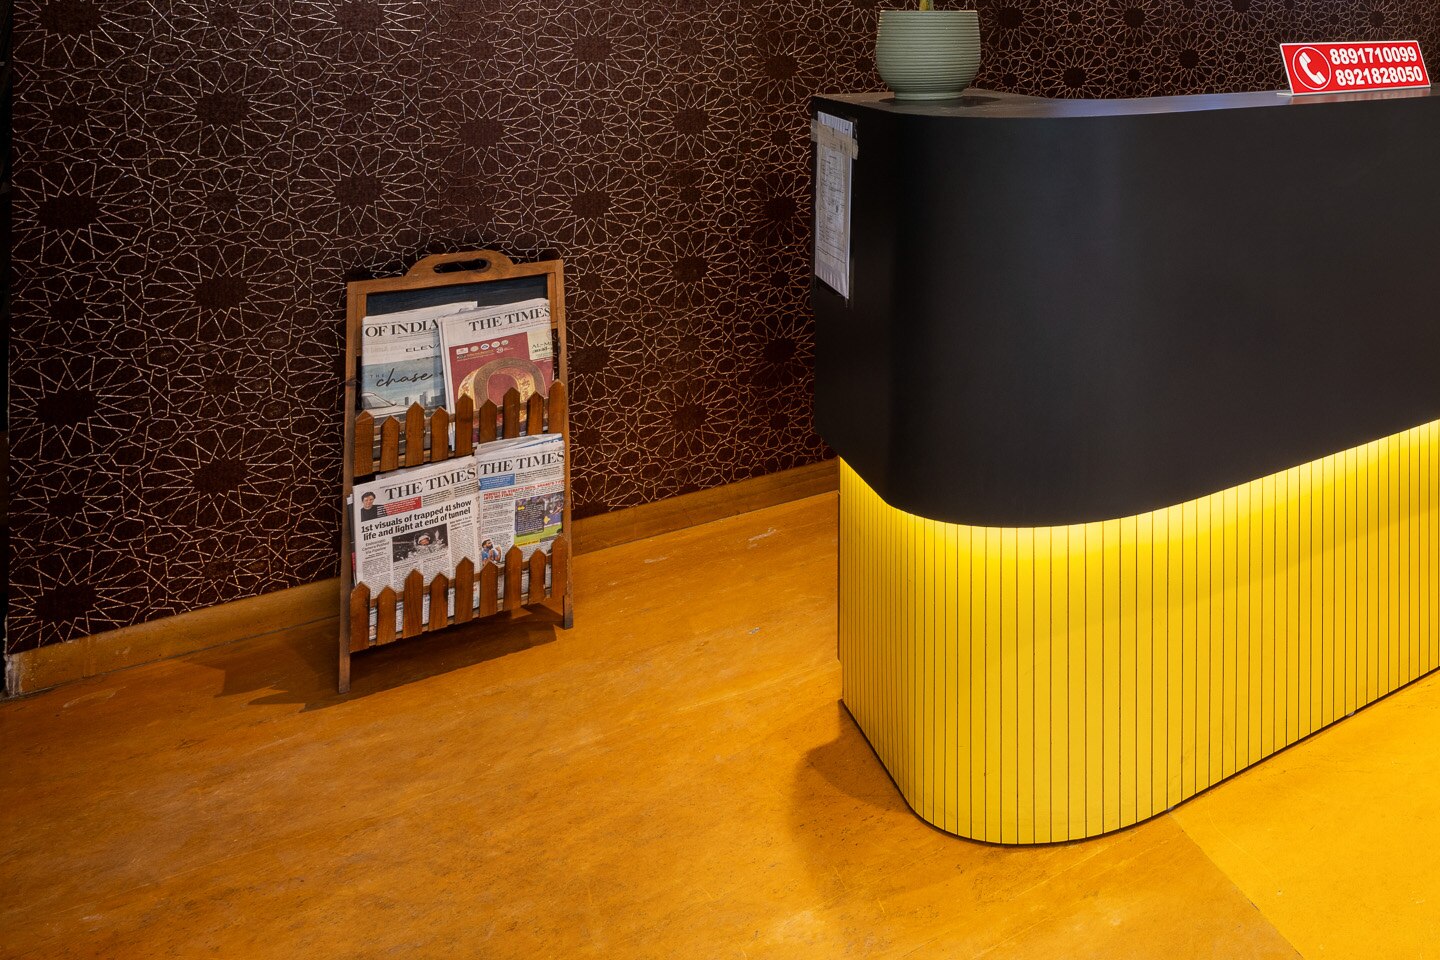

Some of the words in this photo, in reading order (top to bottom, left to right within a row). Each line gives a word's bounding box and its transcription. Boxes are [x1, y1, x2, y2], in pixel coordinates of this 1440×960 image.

[1329, 46, 1418, 65] 8891710099
[1335, 66, 1423, 86] 8921828050
[365, 326, 388, 337] OF
[391, 319, 439, 335] INDIA
[468, 316, 503, 331] THE
[504, 307, 550, 324] TIMES
[405, 343, 440, 353] ELEV
[376, 368, 434, 387] chase
[480, 460, 513, 475] THE
[516, 451, 565, 469] TIMES
[385, 484, 423, 500] THE
[426, 468, 476, 490] TIMES
[361, 524, 374, 533] 1st
[374, 517, 403, 530] visuals
[404, 513, 413, 523] of
[413, 506, 444, 521] trapped
[444, 505, 452, 514] 41
[452, 500, 472, 511] show
[363, 530, 377, 541] life
[378, 526, 394, 537] and
[395, 521, 414, 535] light
[415, 520, 424, 529] at
[424, 515, 439, 526] end
[440, 513, 448, 522] of
[448, 507, 471, 520] tunnel
